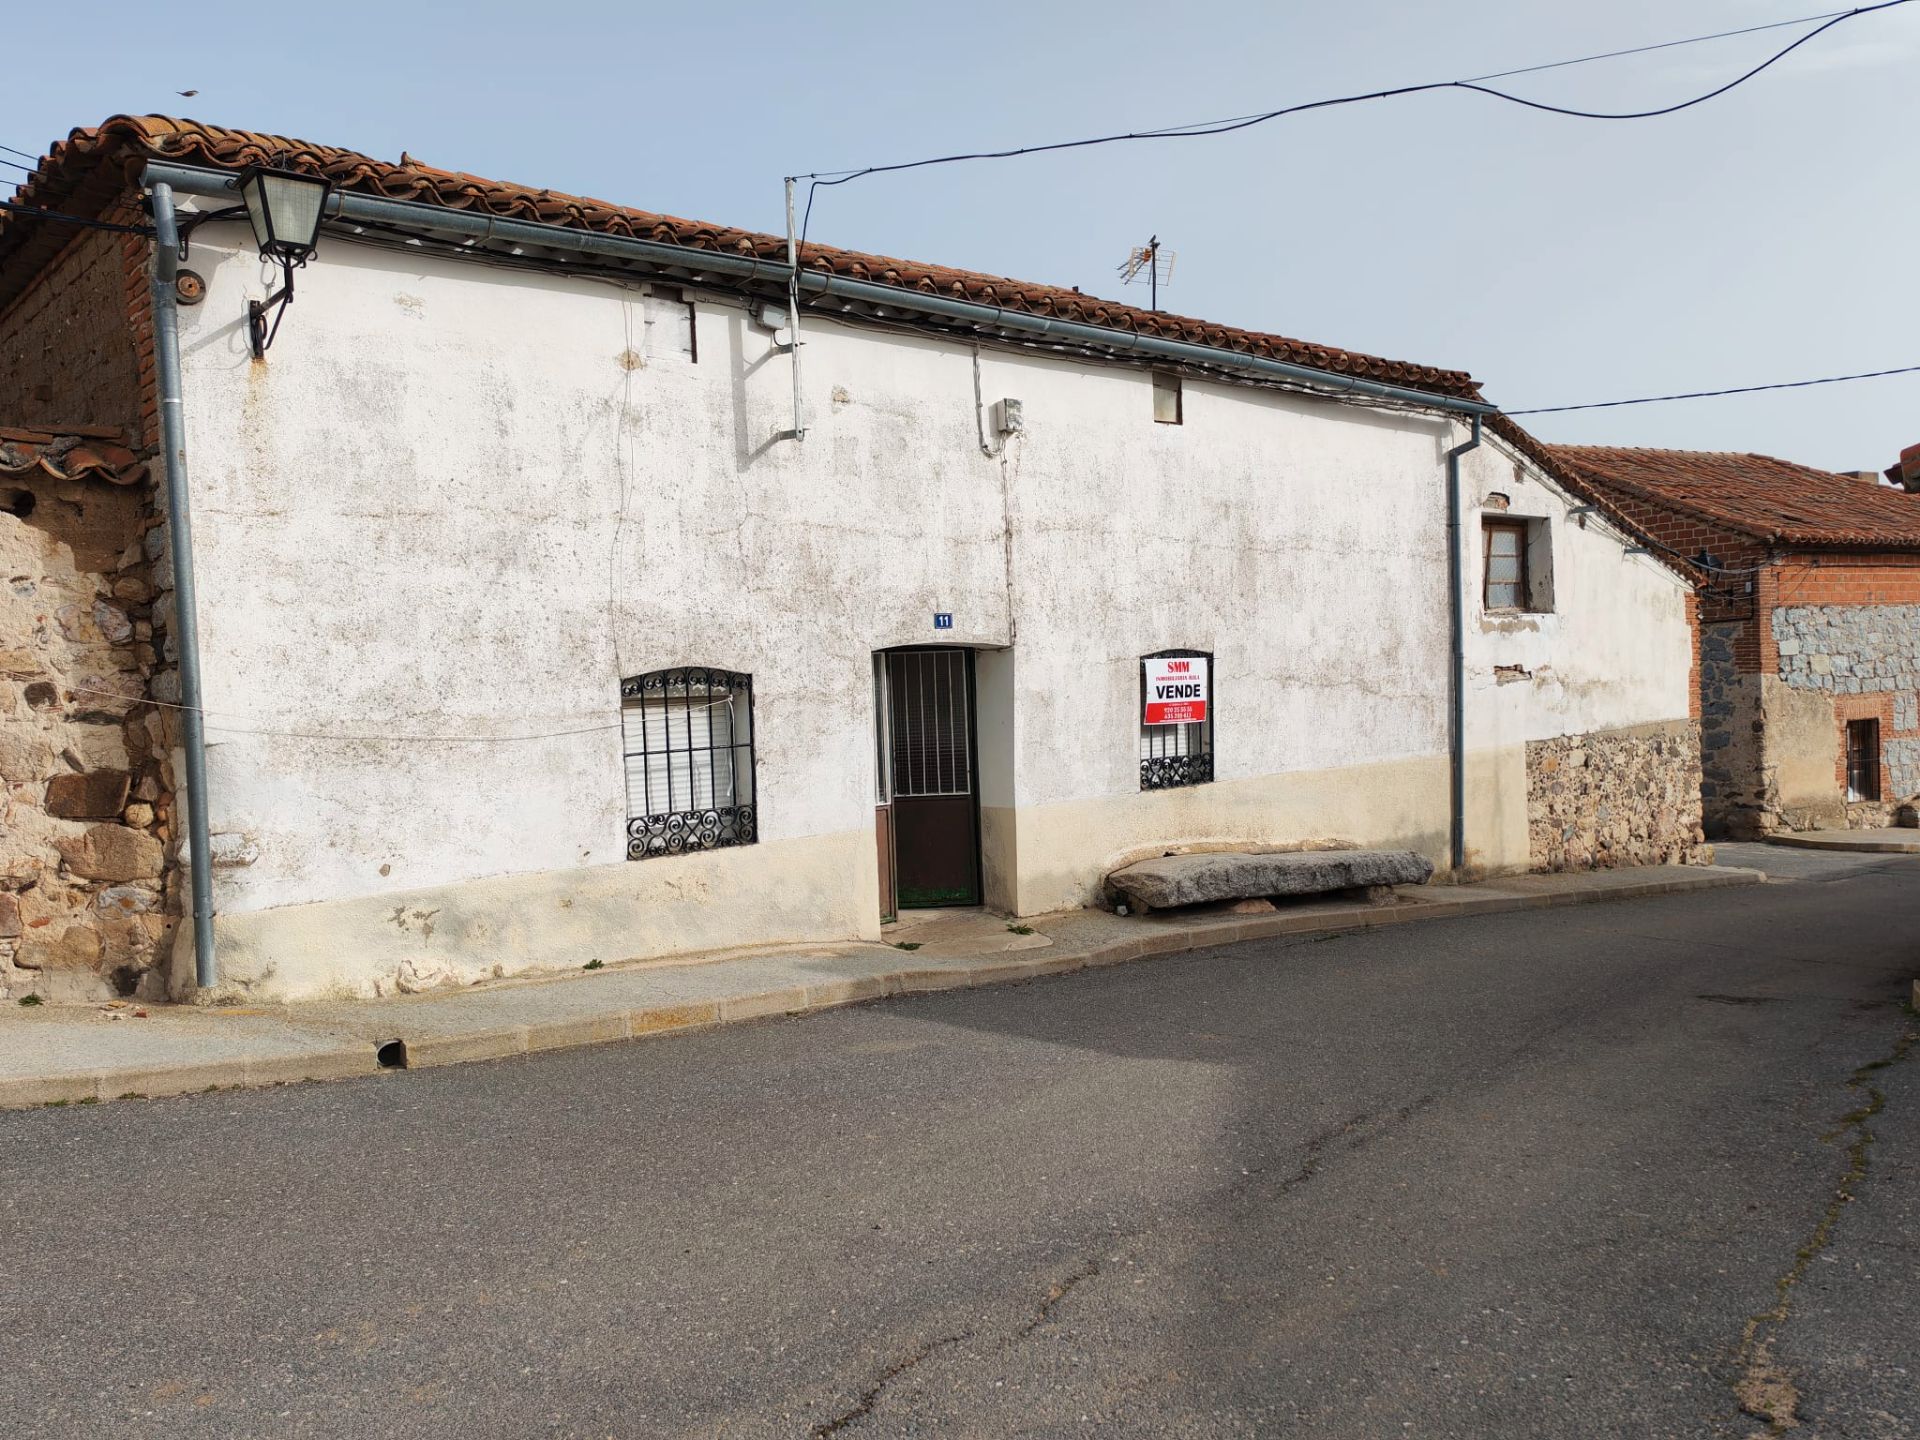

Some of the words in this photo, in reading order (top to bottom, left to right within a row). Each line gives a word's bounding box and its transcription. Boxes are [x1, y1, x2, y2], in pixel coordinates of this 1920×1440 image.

[939, 615, 949, 627] 11
[1167, 661, 1190, 673] SMM
[1155, 684, 1201, 699] VENDE
